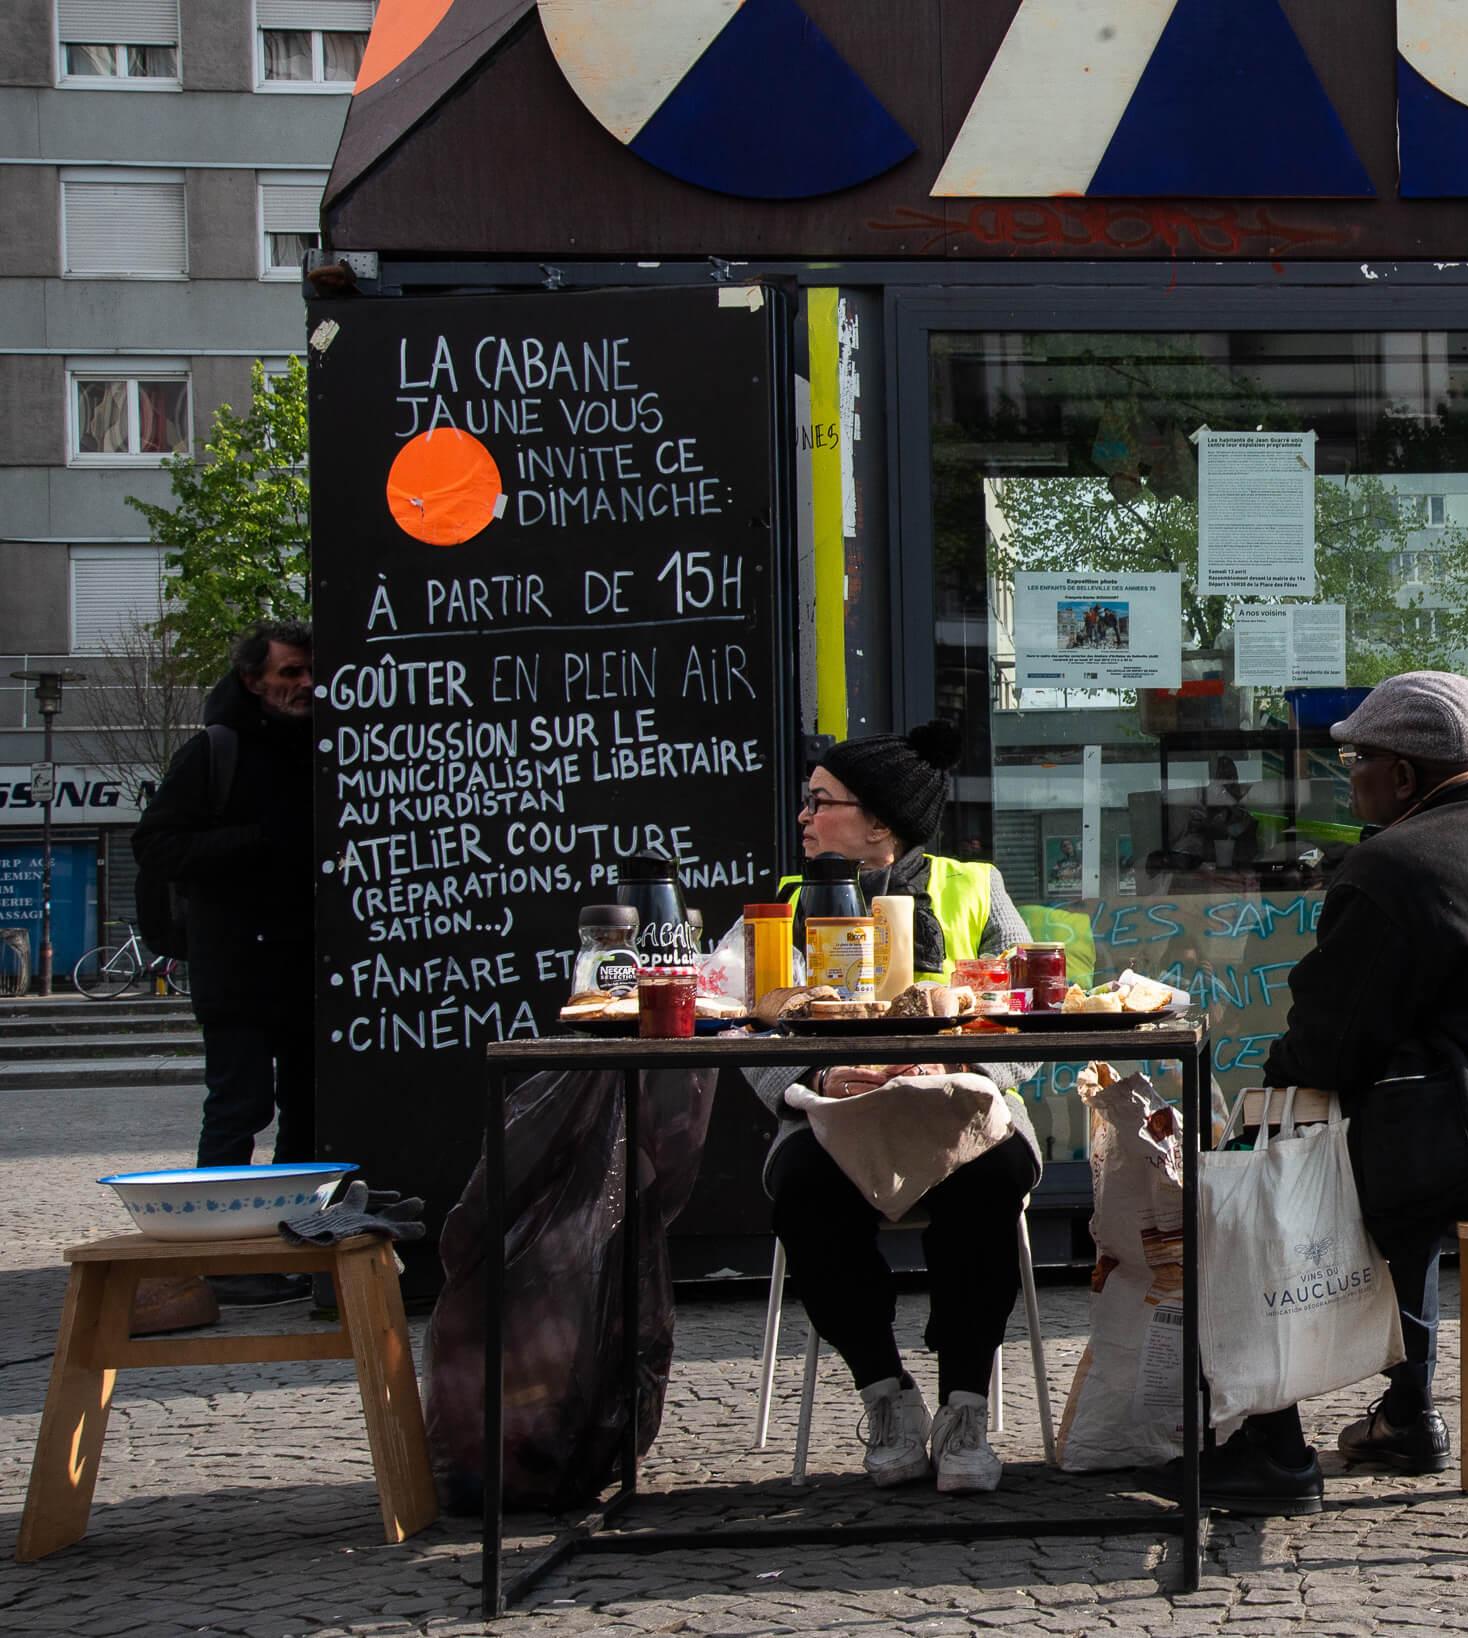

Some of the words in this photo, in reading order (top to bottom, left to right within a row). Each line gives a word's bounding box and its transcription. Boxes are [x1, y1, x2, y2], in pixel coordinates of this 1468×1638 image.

[399, 335, 459, 392] LA
[474, 336, 639, 395] CABANE
[395, 395, 543, 441] JAUNE
[559, 393, 664, 434] VOUS
[516, 443, 641, 482] INVITE
[656, 438, 704, 474] CE
[367, 572, 398, 631] À
[428, 574, 552, 625] PARTIR
[584, 570, 635, 615] DE
[657, 551, 744, 614] 15H
[1246, 609, 1260, 617] nos
[1261, 609, 1287, 617] voisins
[329, 654, 473, 711] GOÛTER
[492, 653, 539, 703] EN
[565, 647, 657, 704] PLEIN
[682, 644, 757, 705] AIR
[338, 717, 518, 767] DISCUSSION
[529, 712, 599, 752] SUR
[613, 708, 659, 746] LE
[337, 753, 582, 800] MUNICIPALISME
[592, 736, 764, 782] LIBERTAIRE
[338, 801, 380, 829] AU
[389, 789, 566, 826] KURDISTAN
[341, 823, 492, 886] ATELIER
[506, 822, 701, 867] COUTURE
[352, 860, 582, 921] (RÉPARATIONS,
[590, 852, 771, 889] PENNALI-
[1204, 896, 1324, 939] SAME
[352, 953, 521, 998] FANFARE
[536, 949, 575, 981] ET
[349, 996, 539, 1052] CINÉMA
[1263, 1267, 1372, 1308] VAUCLUSE
[1301, 1270, 1324, 1283] VINS
[1326, 1267, 1340, 1278] DU
